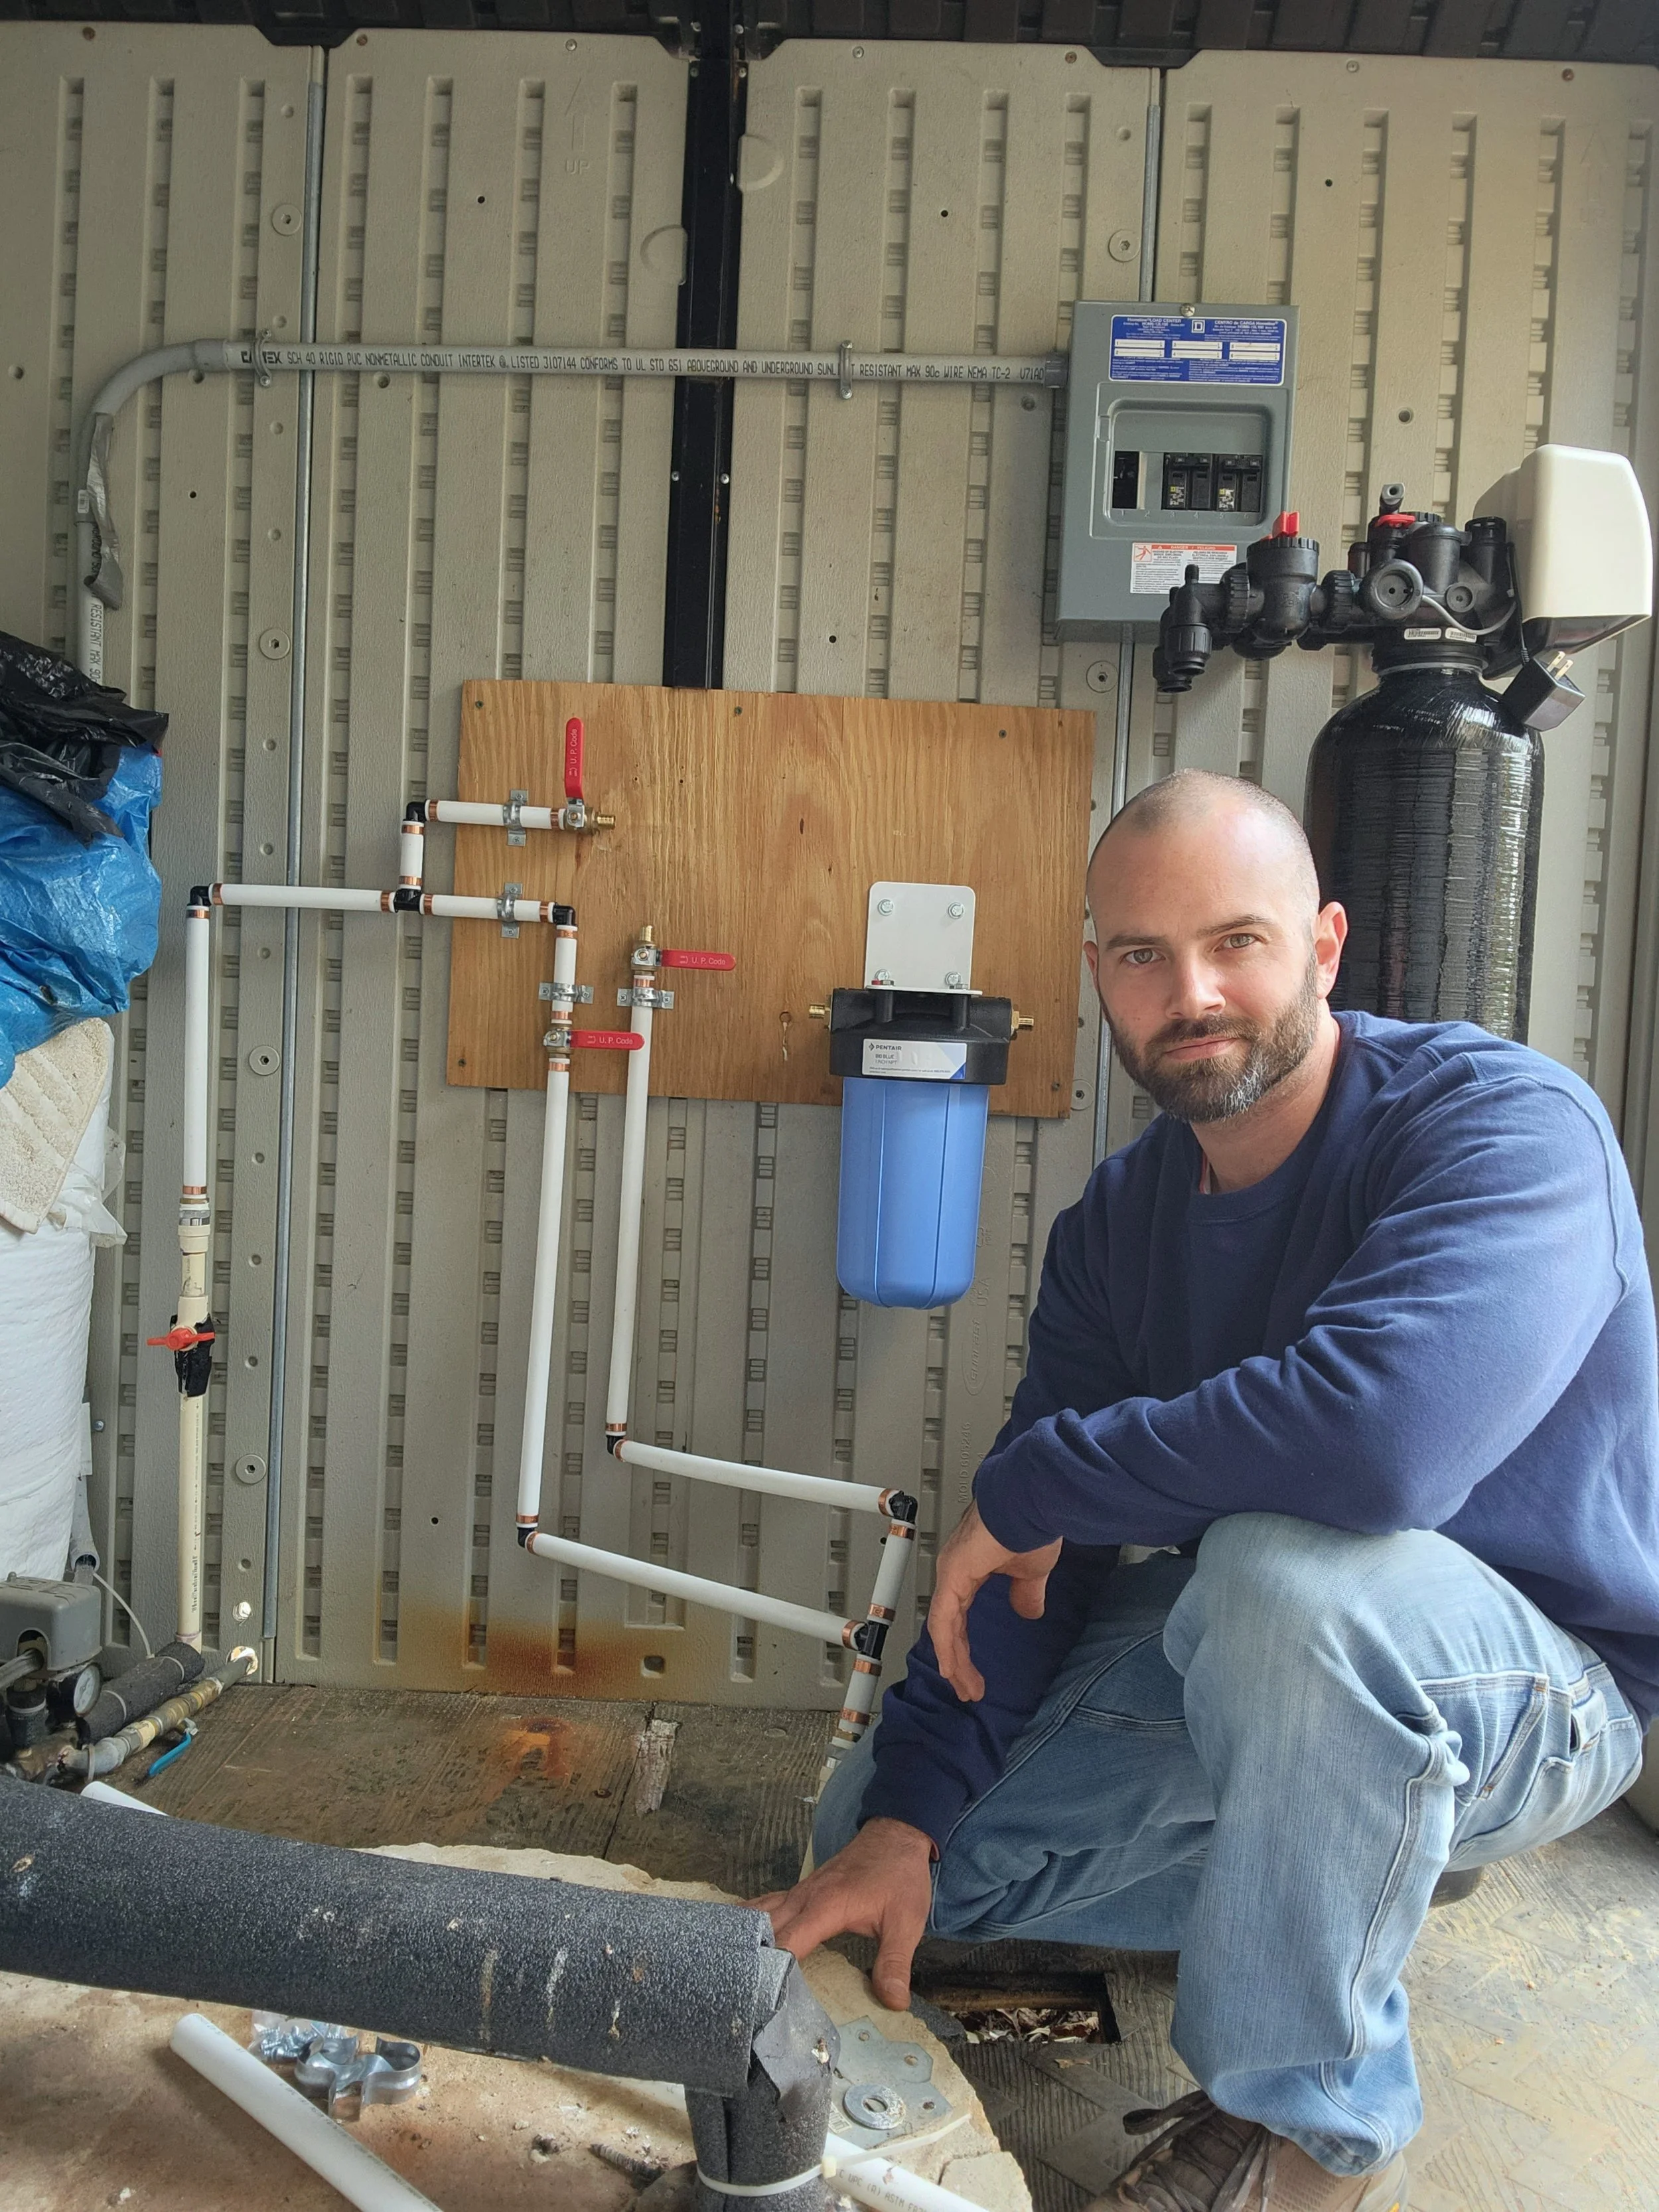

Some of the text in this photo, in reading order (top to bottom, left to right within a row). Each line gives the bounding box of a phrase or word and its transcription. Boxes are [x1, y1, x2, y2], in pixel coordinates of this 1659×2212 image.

[565, 159, 590, 175] UP
[287, 352, 303, 364] SCH
[306, 352, 316, 364] 40
[321, 352, 343, 365] RIGID
[365, 353, 417, 366] NONMETALLIC
[421, 353, 453, 367] CONDUIT
[459, 354, 494, 368] INTERTEK
[511, 356, 540, 369] LISTED
[543, 356, 577, 370] 3107144
[581, 357, 618, 370] CONFORMS
[622, 358, 631, 370] TO
[636, 358, 646, 371] UL
[650, 358, 664, 372] STD
[668, 359, 682, 372] 651
[743, 360, 758, 374] AND
[762, 360, 814, 374] UNDERGROUND
[860, 364, 902, 376] RESISTANT
[906, 364, 920, 377] MAX
[944, 366, 964, 378] WIRE
[968, 366, 987, 378] NEMA
[991, 366, 1011, 379] TC-2
[90, 603, 102, 646] RESISTANT
[89, 650, 102, 665] MAX
[976, 1277, 991, 1306] USA
[884, 2192, 905, 2209] ASTM
